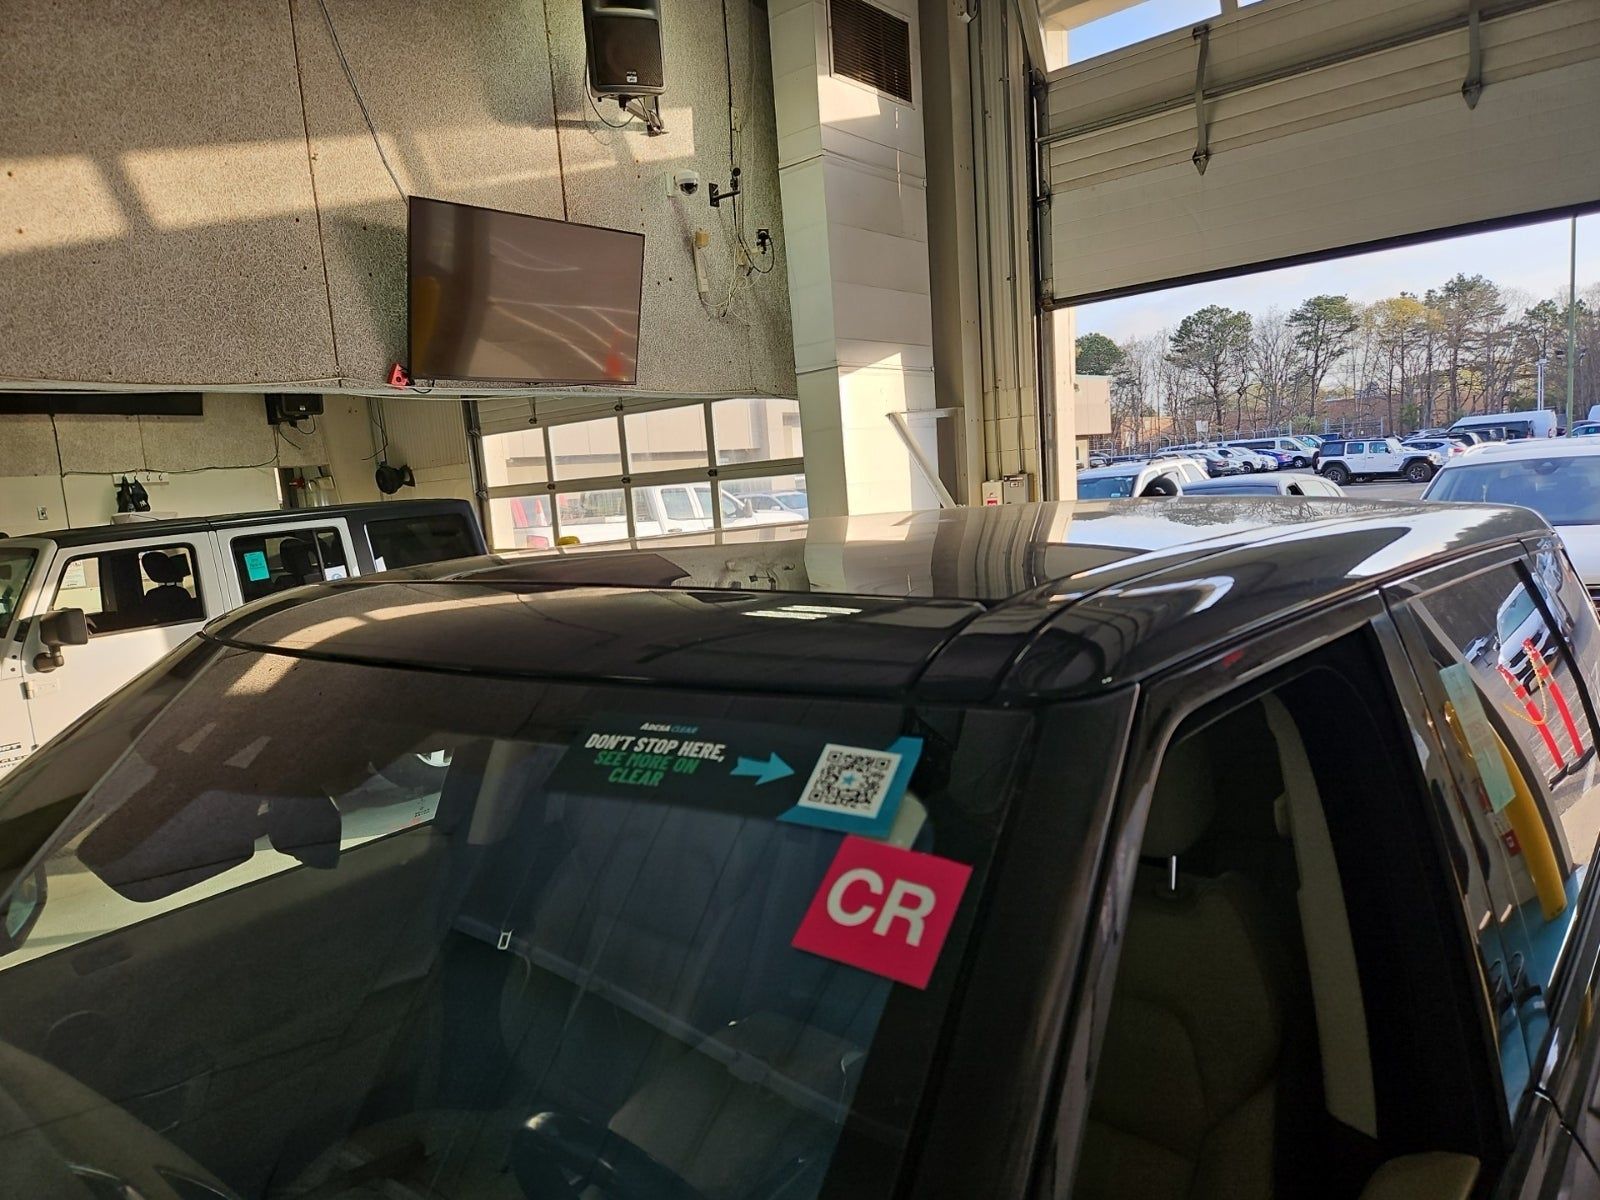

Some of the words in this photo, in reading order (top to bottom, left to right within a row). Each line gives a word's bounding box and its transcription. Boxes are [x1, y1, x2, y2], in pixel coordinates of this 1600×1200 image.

[585, 733, 636, 751] DON'T
[634, 737, 679, 755] STOP
[677, 741, 726, 762] HERE,
[594, 751, 626, 766] SEE
[625, 753, 673, 770] MORE
[673, 758, 700, 774] ON
[608, 767, 664, 786] CLEAR
[827, 867, 936, 947] CR
